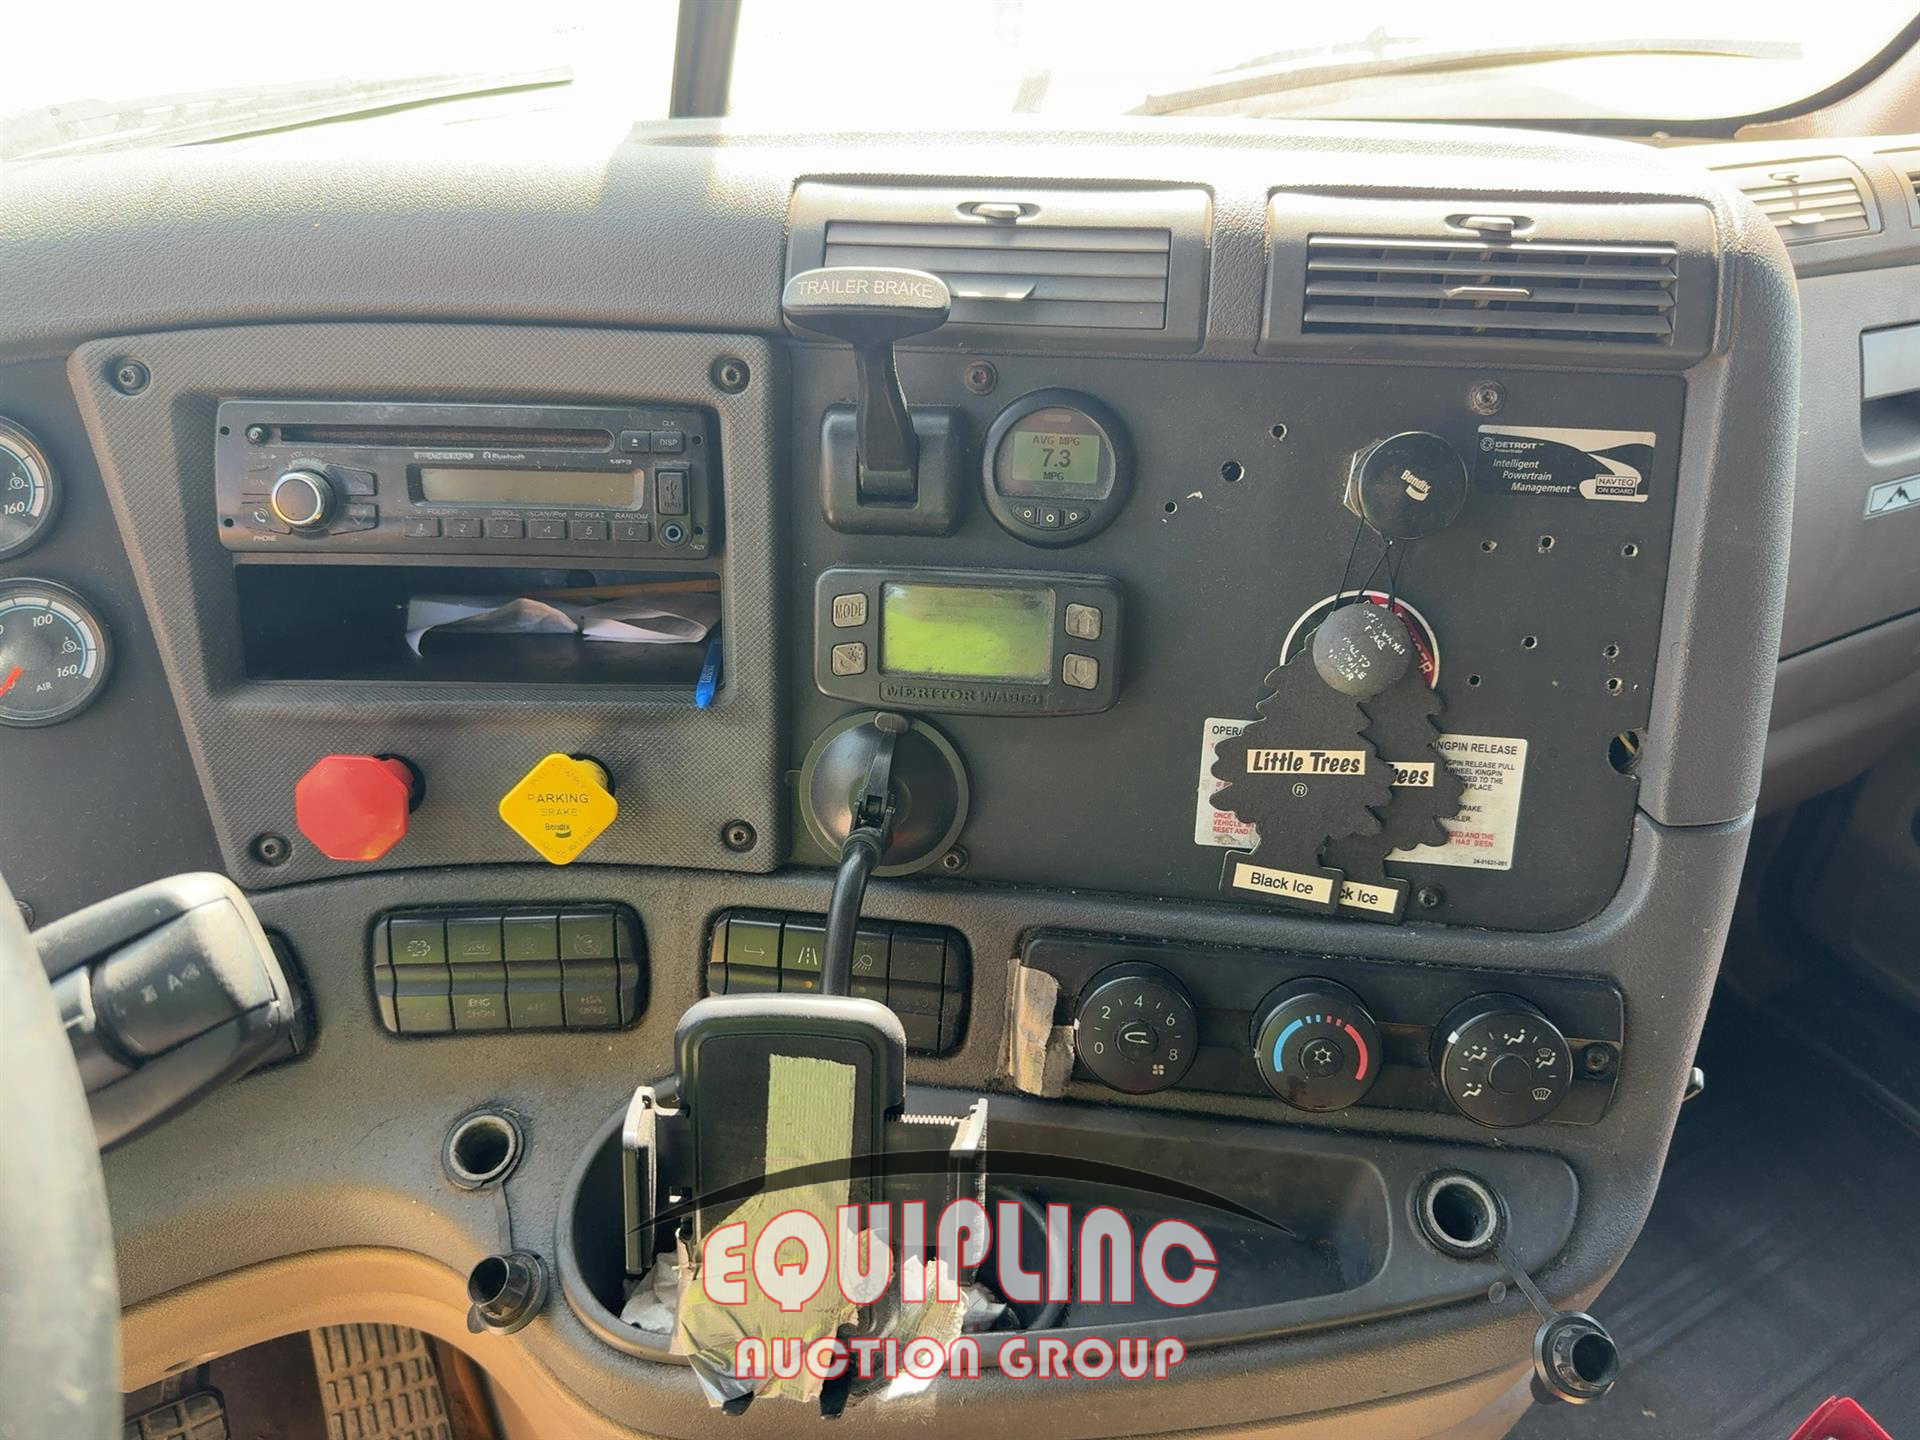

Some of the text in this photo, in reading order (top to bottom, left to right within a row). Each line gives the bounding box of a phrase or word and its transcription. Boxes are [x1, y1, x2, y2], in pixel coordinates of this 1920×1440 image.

[798, 279, 934, 298] TRAILER BRAKE
[1032, 435, 1080, 446] AVG MPG
[1042, 448, 1071, 468] 7.3
[1493, 458, 1539, 471] Intelligent
[1043, 471, 1064, 481] MPG
[1400, 469, 1432, 494] Bendix
[1502, 470, 1552, 481] Powertrain
[1598, 477, 1634, 487] NAVTEQ
[1610, 487, 1634, 496] BOARD
[4, 501, 25, 515] 160
[575, 511, 605, 519] REPEAT
[615, 512, 648, 520] RANDOM
[835, 601, 865, 619] MODE
[32, 614, 53, 628] 100
[56, 664, 78, 678] 160
[36, 682, 53, 693] AIR
[887, 686, 974, 701] MERITOR
[1431, 741, 1518, 755] INGPIN RELEASE
[1253, 751, 1360, 773] Little Trees
[1465, 760, 1497, 769] RELEASE
[1475, 769, 1503, 777] KINGPIN
[1490, 777, 1504, 785] THE
[527, 793, 589, 804] PARKING
[540, 808, 578, 816] BRAKE
[1464, 831, 1480, 839] AND
[1250, 871, 1314, 894] Black Ice
[1357, 889, 1379, 905] Ice
[1134, 994, 1143, 1009] 4
[1101, 1005, 1111, 1020] 2
[1166, 1012, 1176, 1026] 6
[1094, 1041, 1104, 1055] 0
[1168, 1048, 1178, 1061] 8
